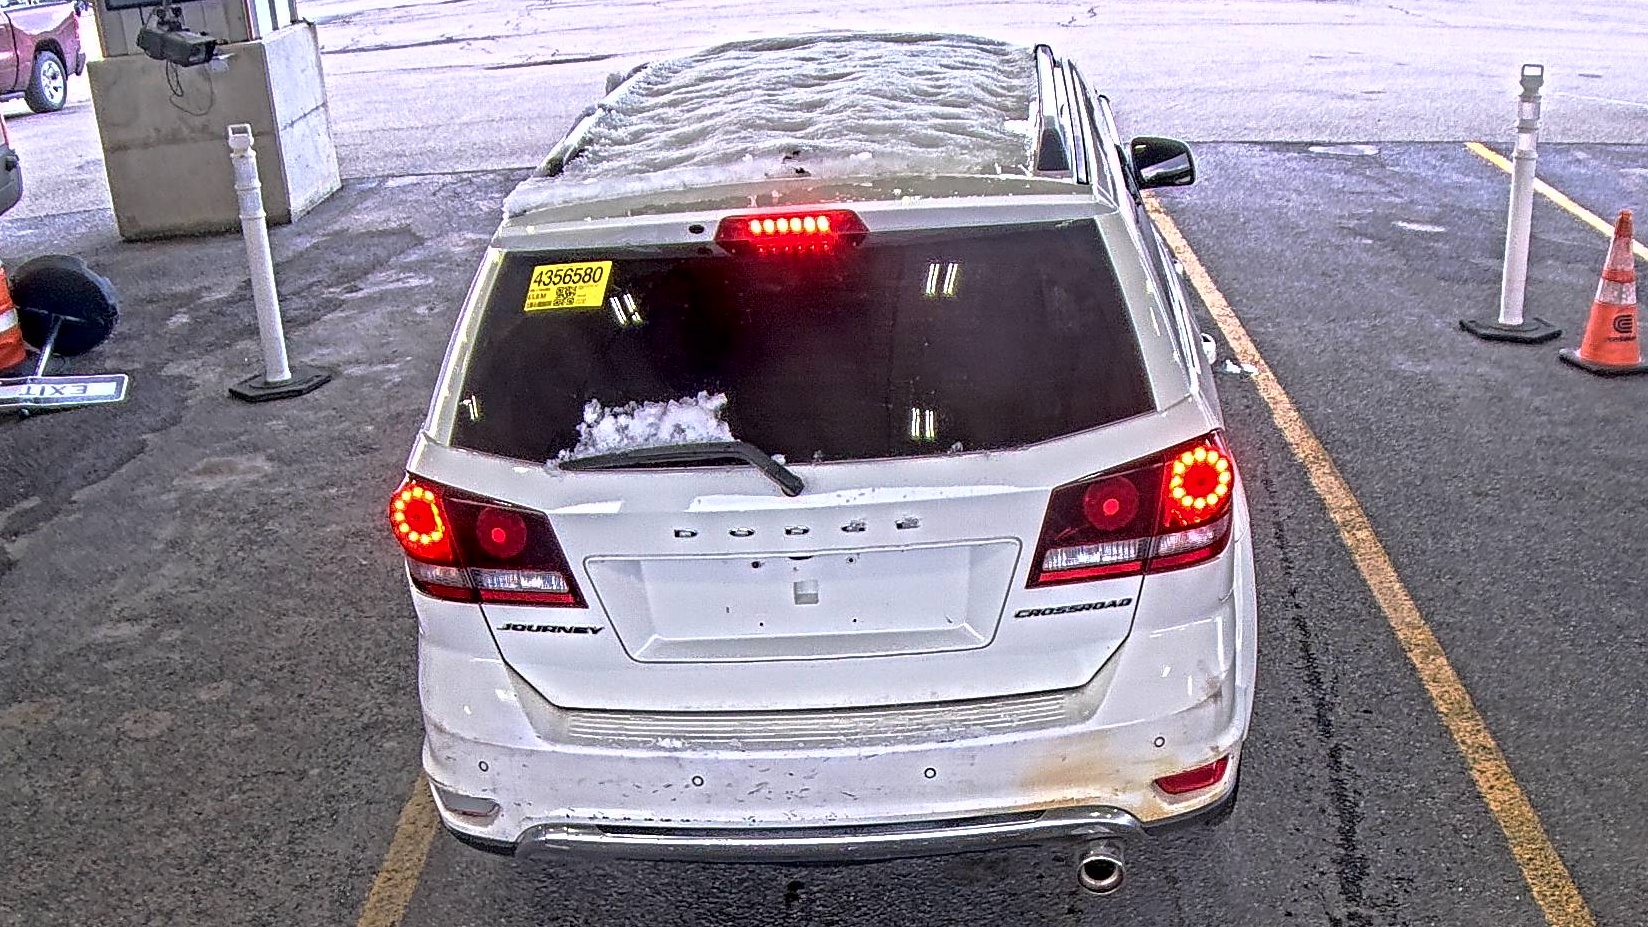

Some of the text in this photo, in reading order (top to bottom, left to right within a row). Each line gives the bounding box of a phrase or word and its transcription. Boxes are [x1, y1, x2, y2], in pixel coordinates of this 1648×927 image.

[533, 266, 604, 287] 4356580
[19, 385, 88, 396] EXIT
[673, 516, 921, 538] DODGE
[1014, 598, 1133, 618] CROSSROAD
[496, 623, 605, 635] JOURNEY
